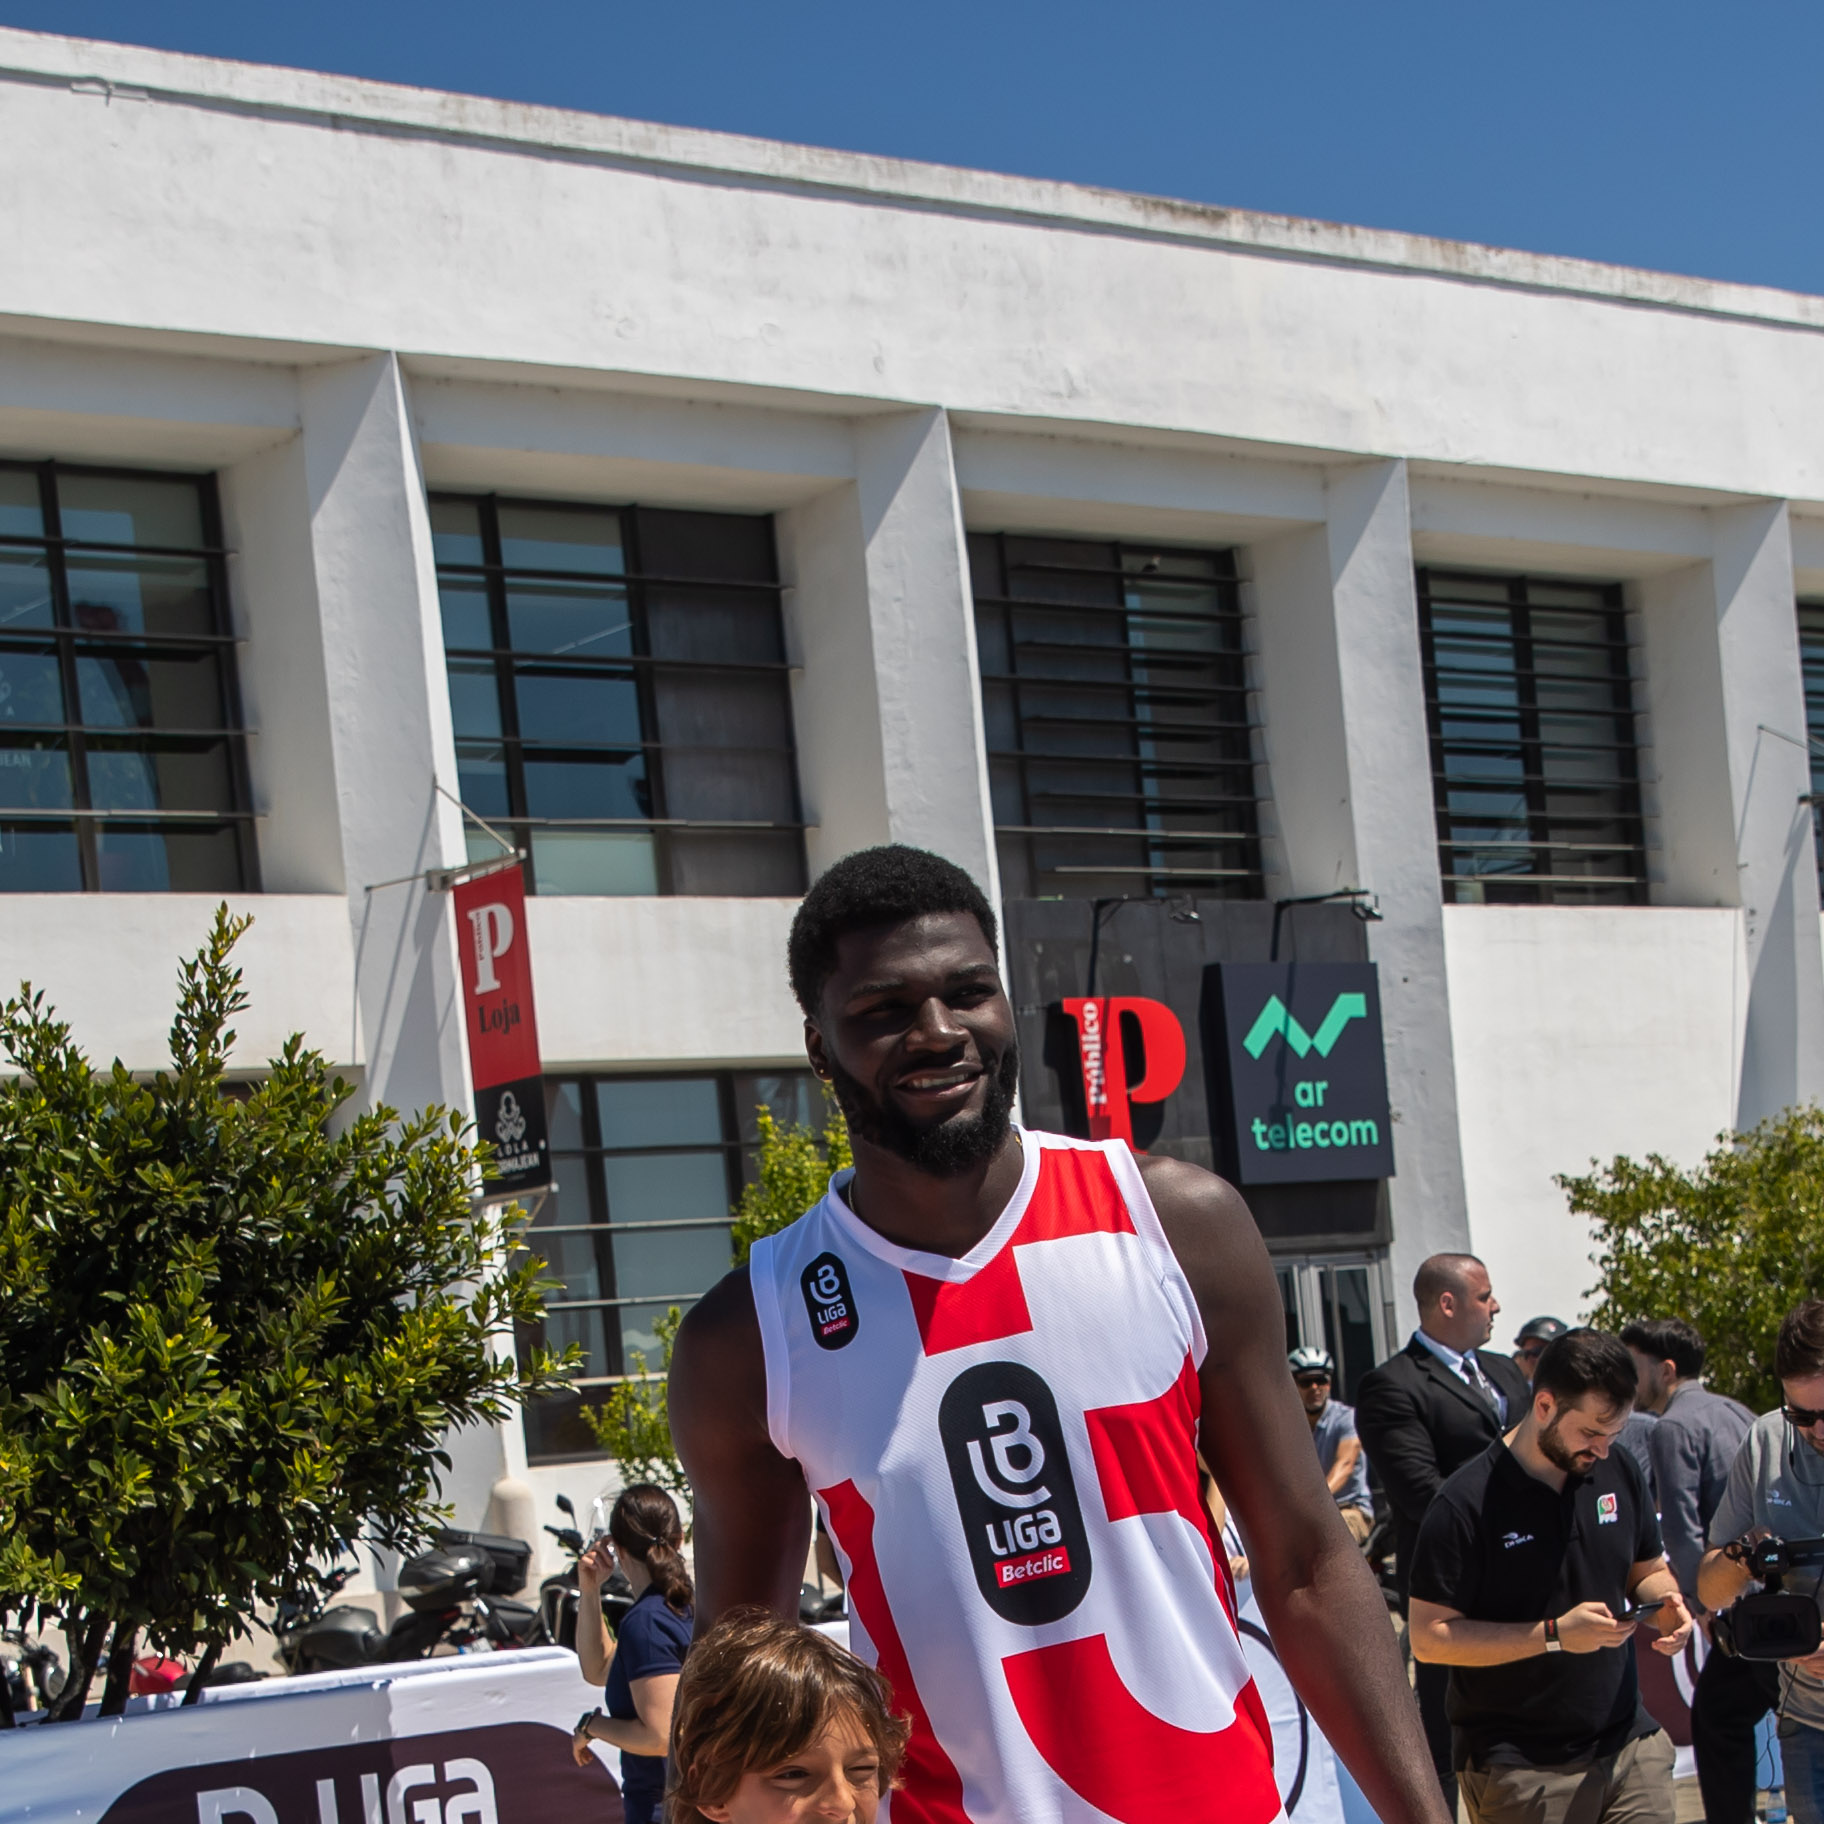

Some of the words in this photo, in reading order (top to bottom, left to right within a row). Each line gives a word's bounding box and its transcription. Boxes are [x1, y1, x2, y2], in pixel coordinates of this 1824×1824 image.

[478, 1000, 521, 1034] Loja
[1294, 1080, 1329, 1108] ar
[1250, 1113, 1379, 1151] telecom
[823, 1320, 848, 1335] Betclic
[1002, 1554, 1064, 1583] Betclic
